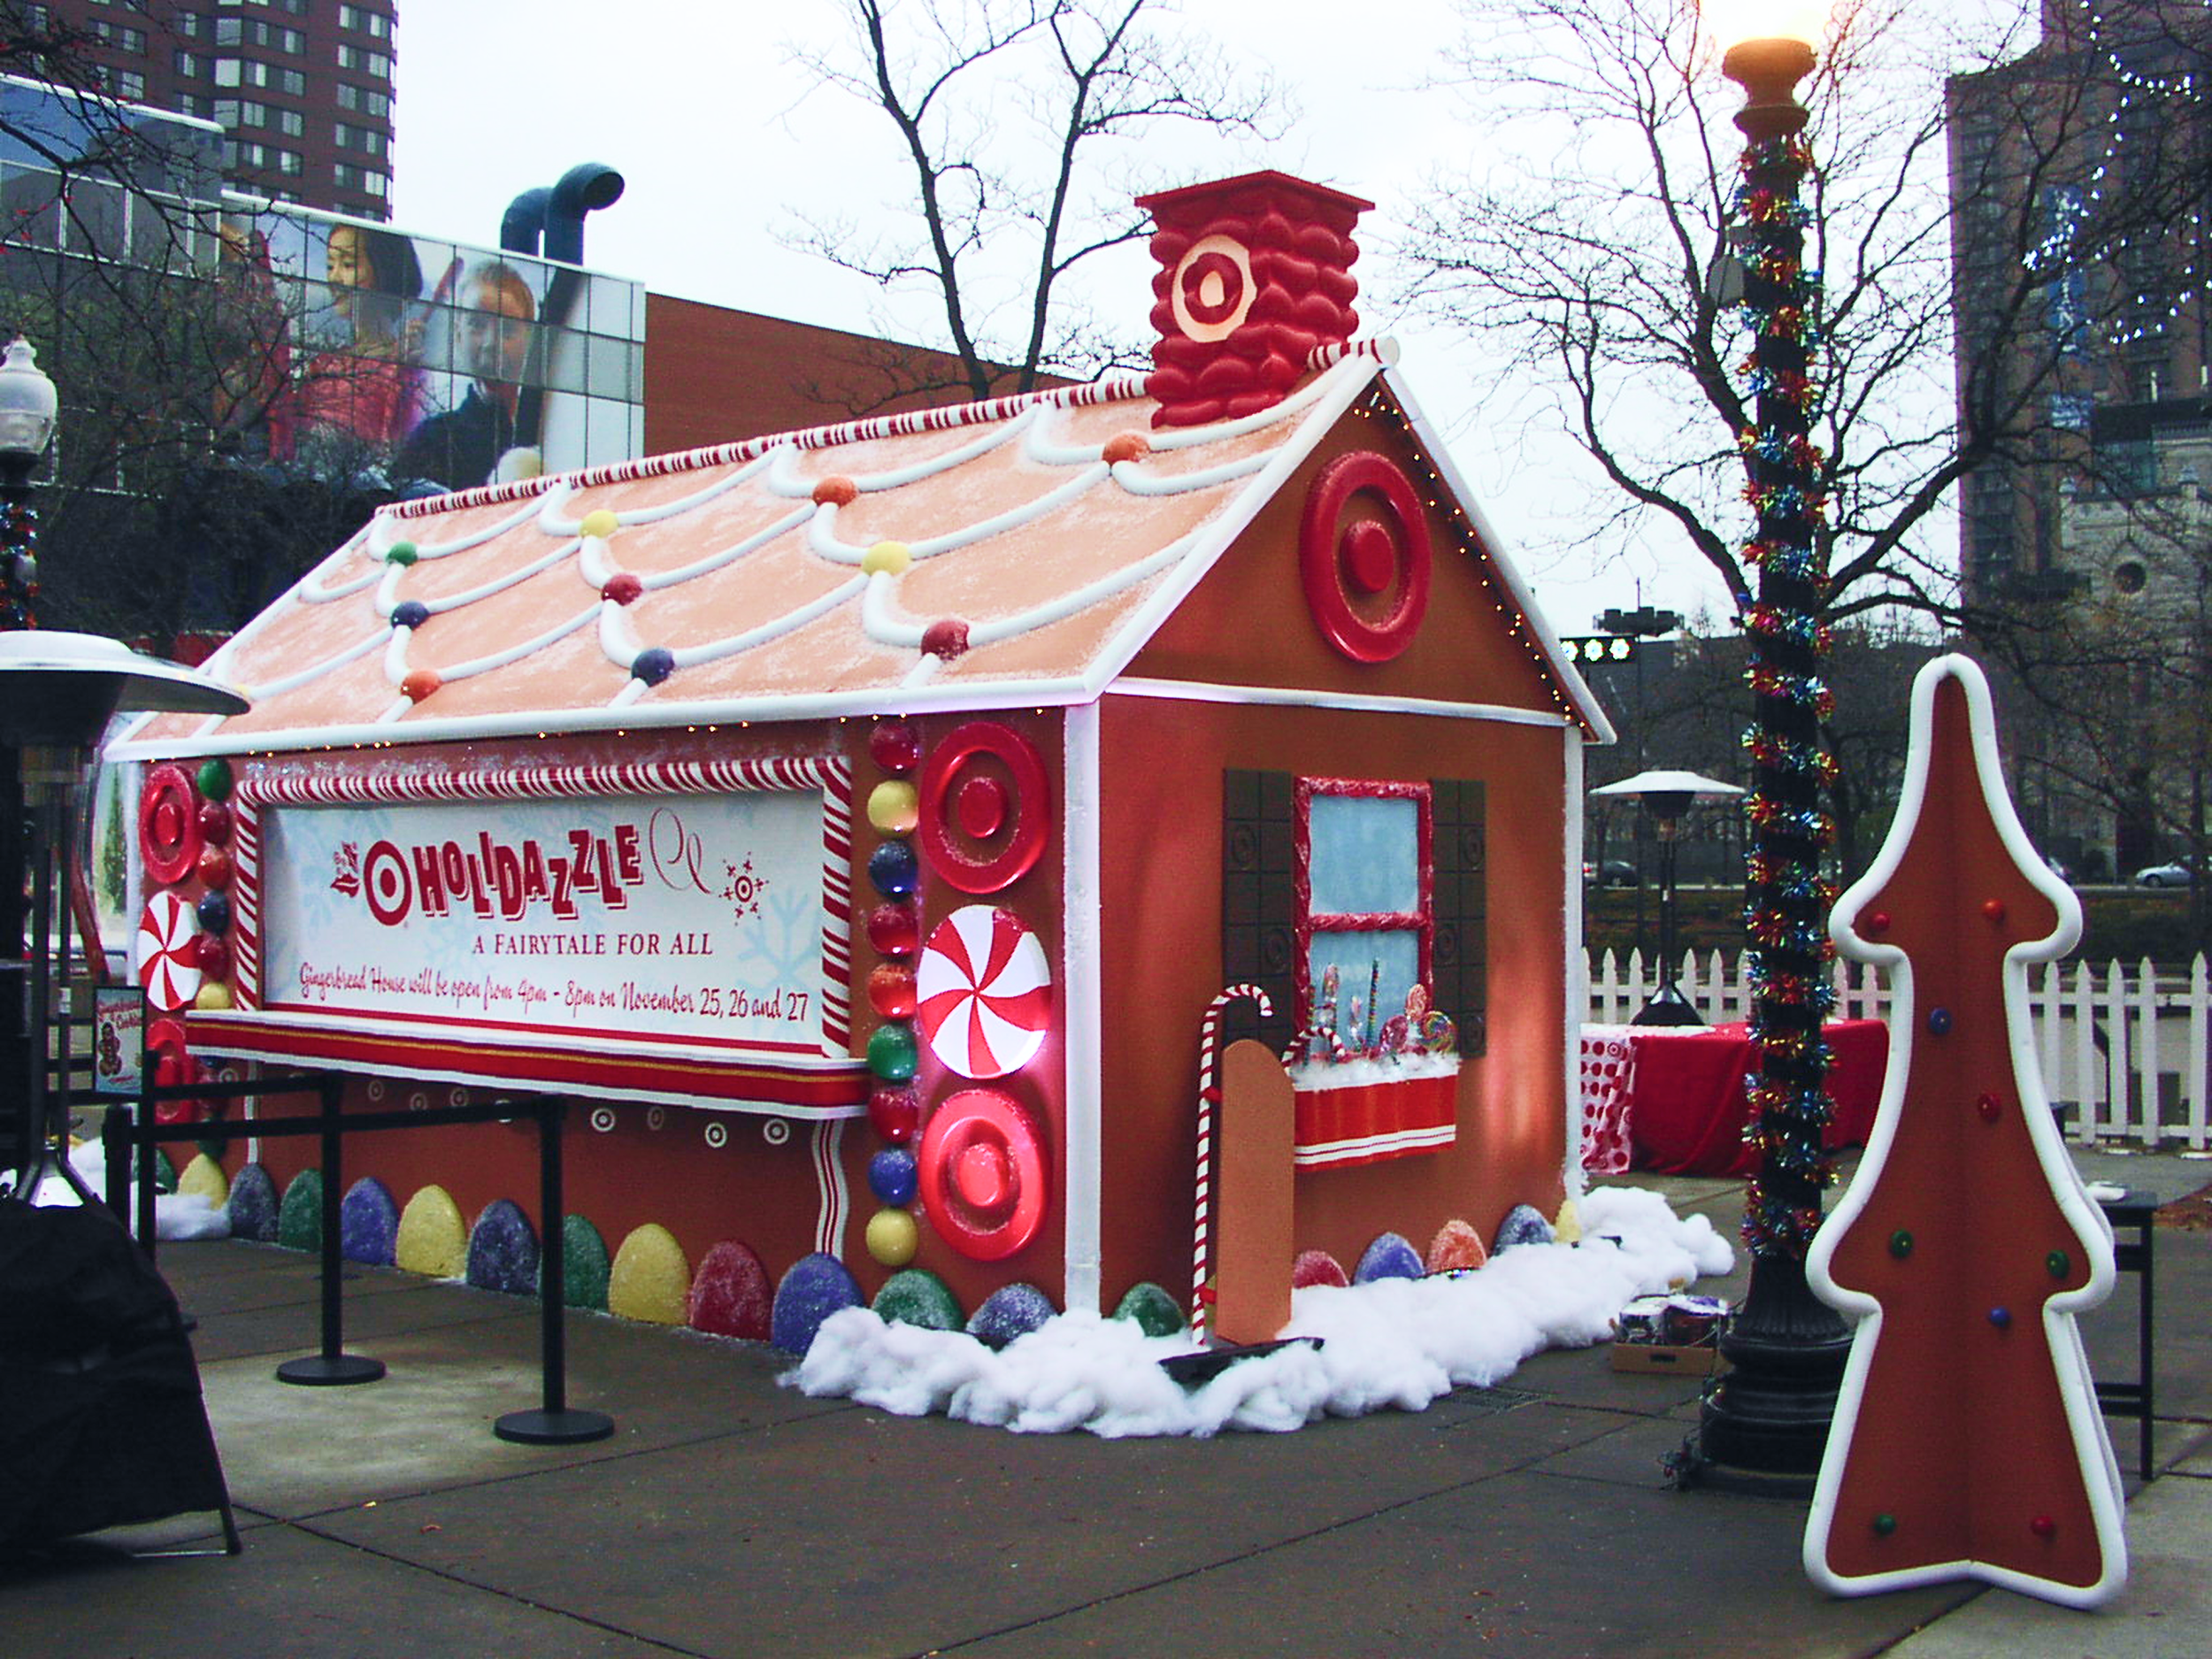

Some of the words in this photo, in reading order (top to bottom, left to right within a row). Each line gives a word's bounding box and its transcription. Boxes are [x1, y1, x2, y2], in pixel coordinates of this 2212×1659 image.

[411, 824, 643, 920] HOLIDAZZLE
[472, 935, 485, 955] A
[494, 933, 606, 956] FAIRYTALE
[617, 933, 660, 955] FOR
[670, 932, 713, 955] ALL
[300, 962, 366, 1001] Gingerbread
[370, 965, 406, 994] House
[409, 967, 433, 994] will
[435, 971, 449, 996] be
[451, 979, 480, 1009] open
[483, 974, 512, 1010] from
[518, 978, 547, 1014] 4pm
[565, 979, 595, 1018] 8pm
[599, 989, 616, 1007] on
[620, 981, 695, 1013] November
[700, 987, 724, 1018] 25,
[728, 989, 749, 1018] 26
[751, 987, 781, 1018] and
[787, 992, 809, 1021] 27
